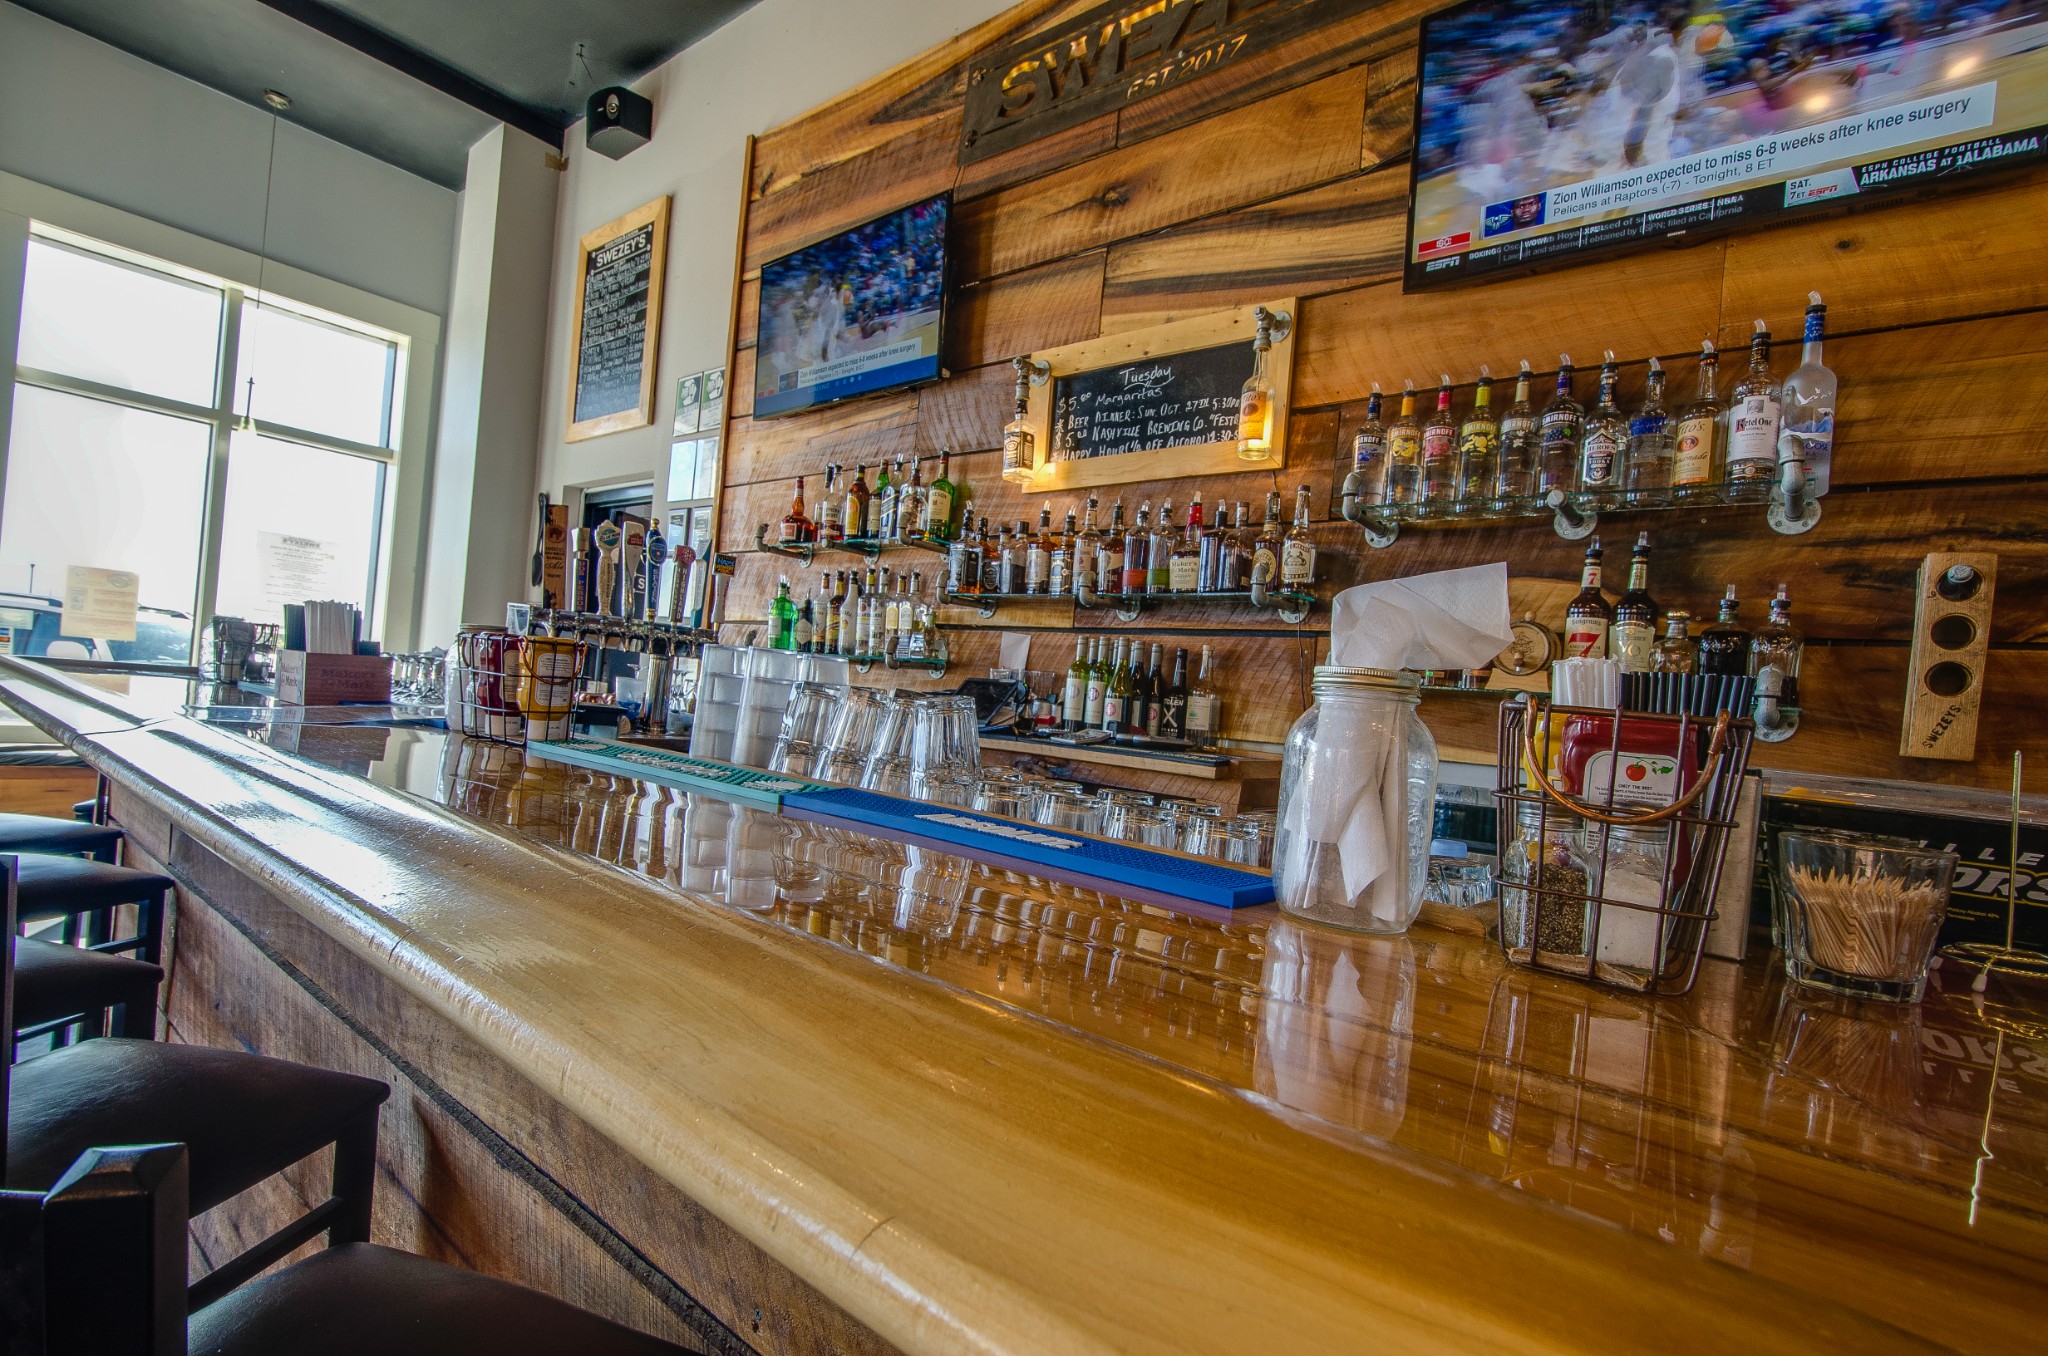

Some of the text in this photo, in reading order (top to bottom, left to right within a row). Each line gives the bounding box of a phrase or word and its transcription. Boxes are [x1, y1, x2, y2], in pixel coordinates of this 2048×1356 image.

[1553, 97, 1971, 205] Zion Williamson expected to miss 6-8 weeks after knee surgery
[1861, 137, 2001, 173] ESPN COLLEGE FOOTBALL
[1860, 158, 1936, 186] ARKANSAS
[1940, 157, 1954, 168] AT
[1553, 201, 1598, 217] Pelicans
[1600, 196, 1611, 206] at
[1614, 187, 1658, 204] Raptors
[1662, 180, 1681, 194] (-7)
[1693, 167, 1741, 185] Tonight,
[1745, 163, 1753, 172] 8
[1757, 158, 1774, 170] ET
[1790, 179, 1812, 190] SAT.
[1808, 184, 1838, 197] ESPN
[596, 233, 647, 267] SWEZEY'S
[1426, 255, 1460, 272] ESPN
[1119, 365, 1172, 386] Tuesday
[1095, 386, 1163, 407] Margaritas
[1068, 414, 1089, 430] BEER
[1092, 425, 1141, 441] NASHVILLE
[1147, 419, 1190, 436] BREWING
[1464, 423, 1497, 432] SMIRNOFF
[1736, 417, 1772, 433] Ketel One
[1062, 448, 1091, 461] HAPPY
[1588, 573, 1597, 585] 7
[1568, 632, 1601, 658] 7
[1923, 705, 1962, 749] SWEZEYS
